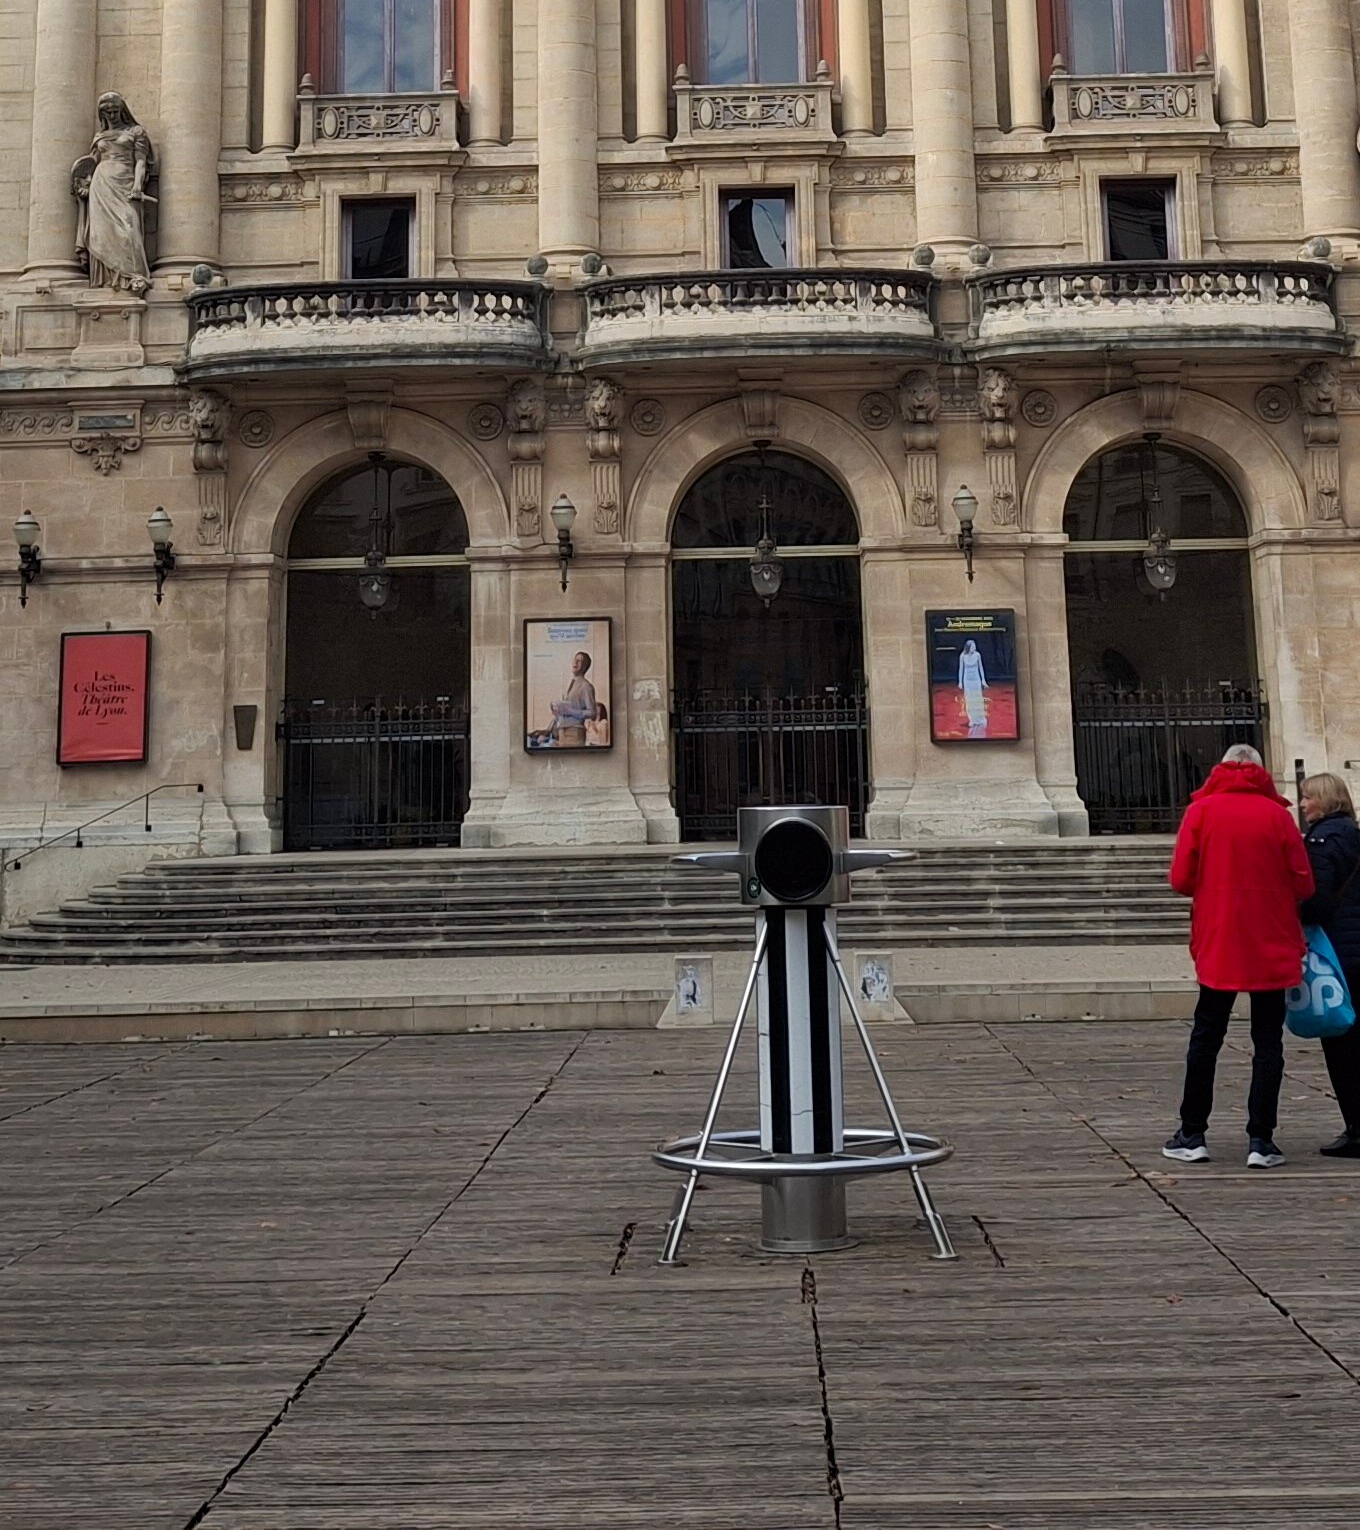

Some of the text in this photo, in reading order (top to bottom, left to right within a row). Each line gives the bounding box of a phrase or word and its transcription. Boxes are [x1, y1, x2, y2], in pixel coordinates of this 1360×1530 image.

[94, 671, 117, 682] Les
[73, 681, 135, 693] Célestins.
[81, 693, 128, 705] Théâtre
[77, 705, 128, 719] de Lyon.
